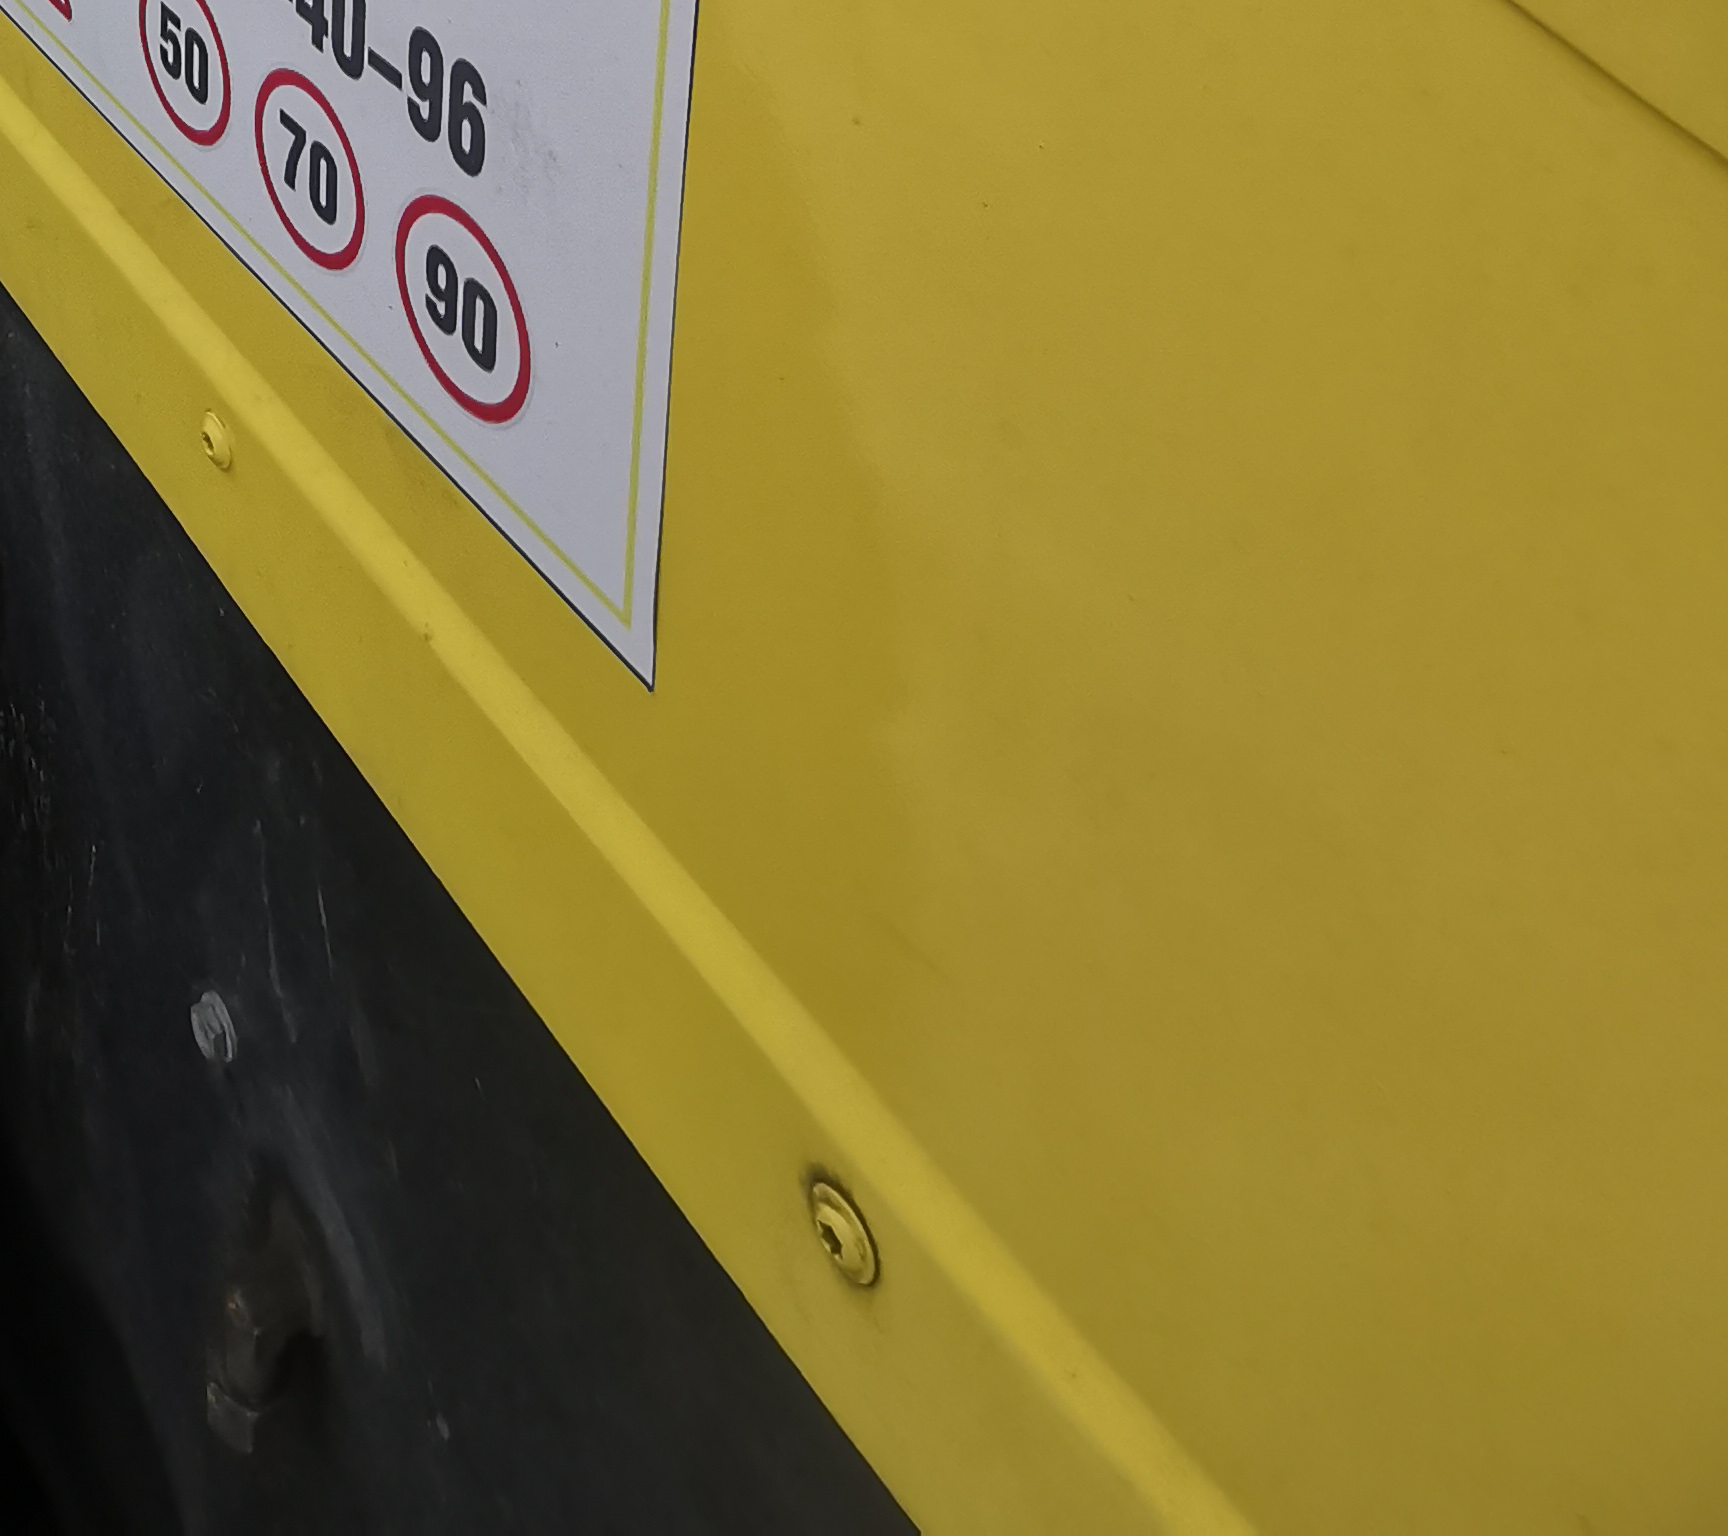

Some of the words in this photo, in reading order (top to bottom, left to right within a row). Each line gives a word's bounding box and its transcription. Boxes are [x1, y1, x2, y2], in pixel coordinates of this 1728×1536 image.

[158, 0, 210, 106] 50
[278, 107, 339, 227] 70
[423, 243, 499, 374] 90
